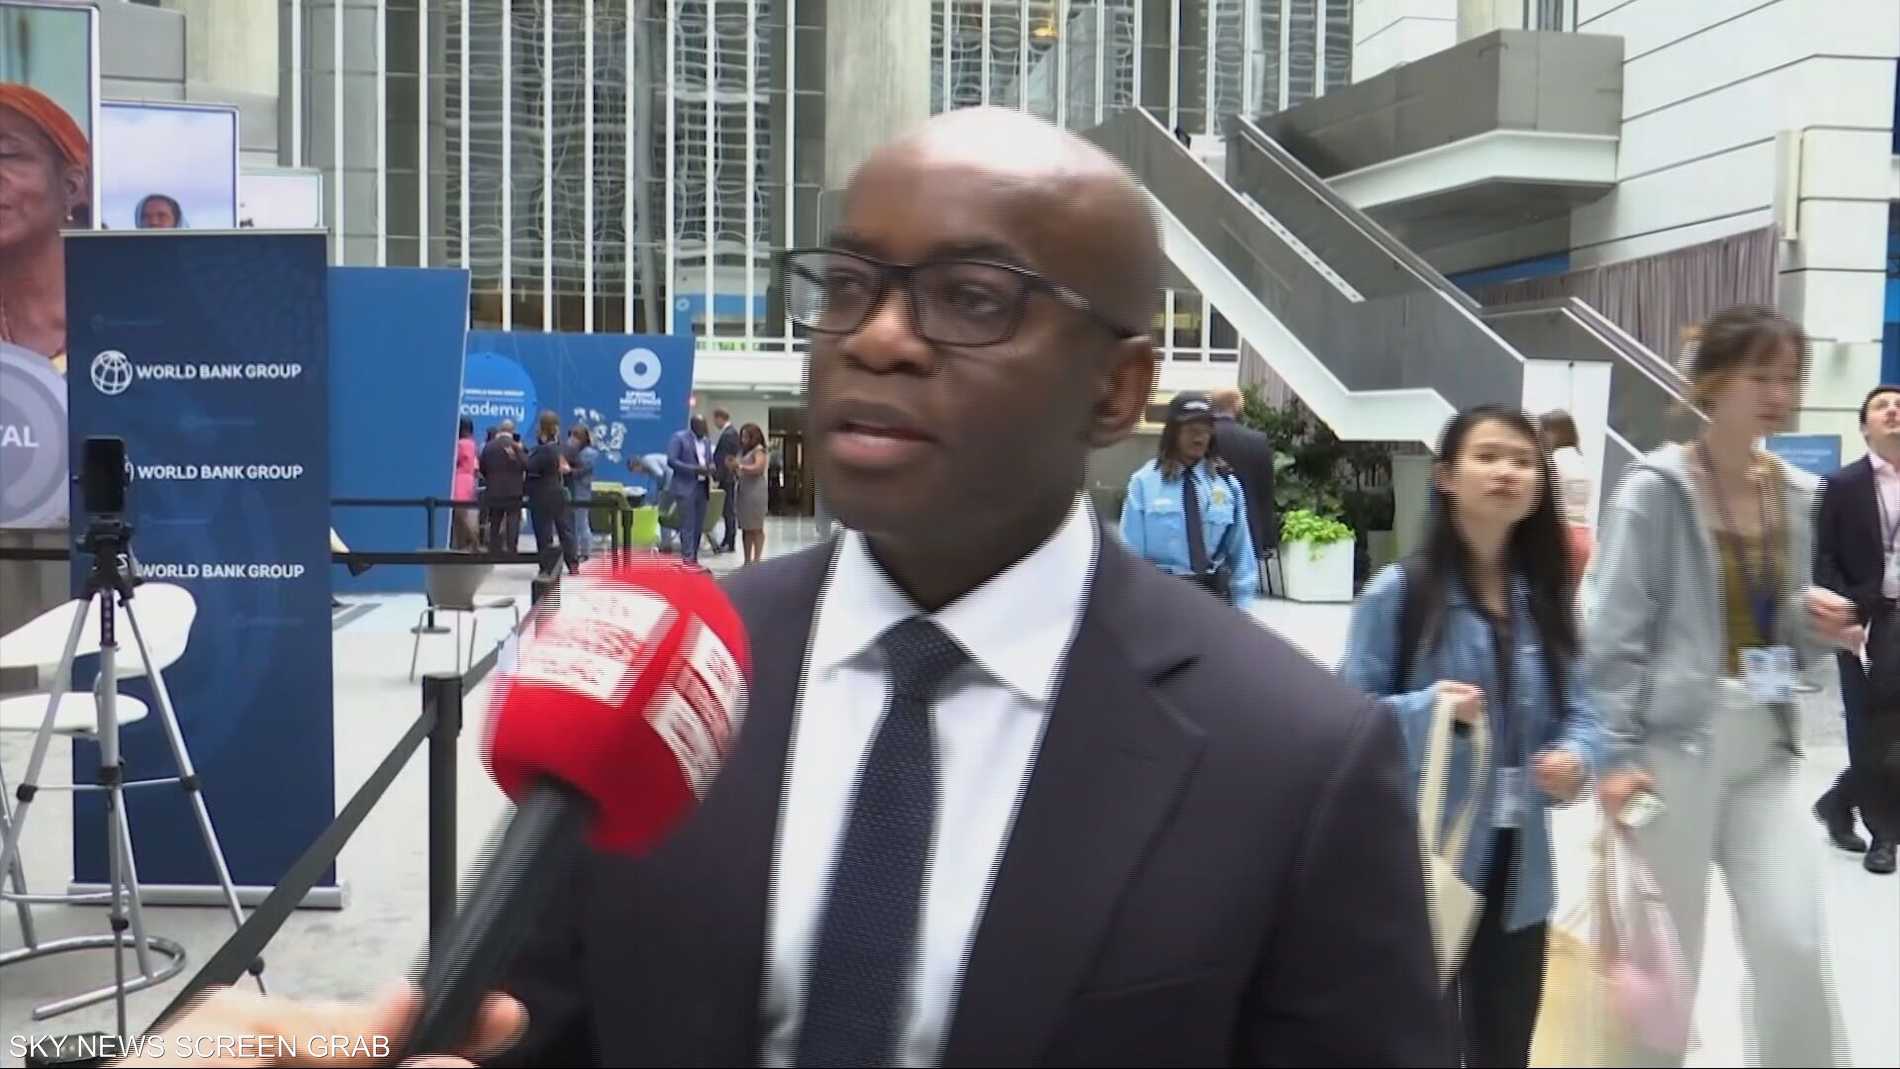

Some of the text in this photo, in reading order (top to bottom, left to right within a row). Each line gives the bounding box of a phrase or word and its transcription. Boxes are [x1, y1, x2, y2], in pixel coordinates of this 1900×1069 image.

[136, 363, 302, 379] WORLD BANK GROUP
[0, 425, 39, 447] AL
[137, 465, 303, 480] WORLD BANK GROUP
[138, 564, 305, 578] WORLD BANK GROUP
